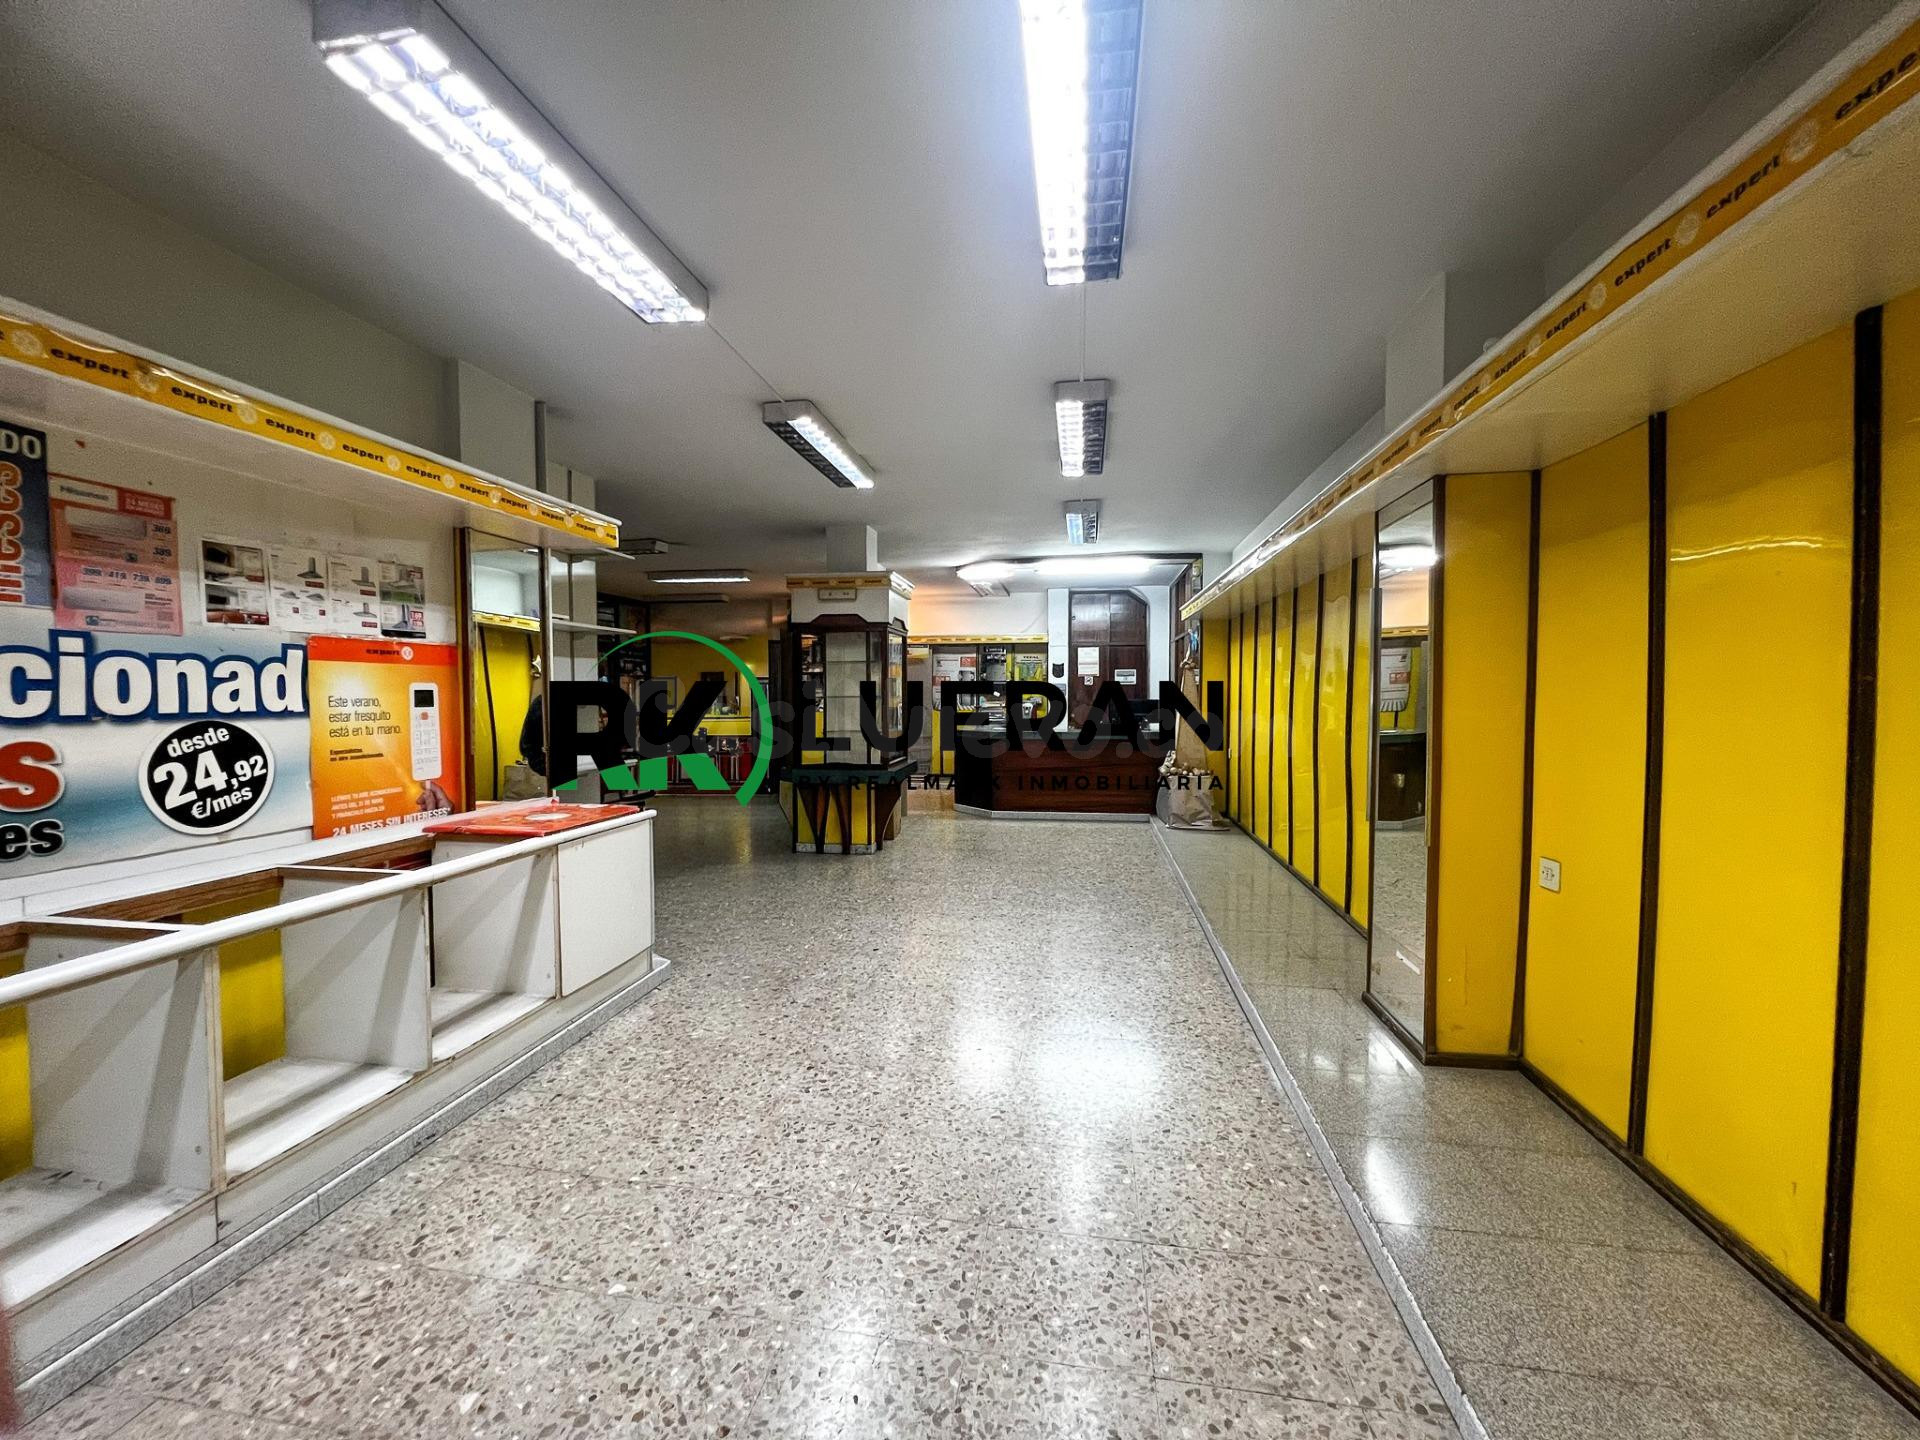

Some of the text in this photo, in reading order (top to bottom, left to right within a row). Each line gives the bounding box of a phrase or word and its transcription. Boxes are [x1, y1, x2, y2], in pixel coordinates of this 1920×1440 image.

[1546, 302, 1587, 339] expert
[1614, 238, 1672, 287] expert
[1706, 155, 1780, 219] expert
[1835, 46, 1920, 120] expe
[50, 347, 130, 380] expert
[171, 386, 233, 413] expert
[265, 417, 316, 441] expert
[342, 443, 384, 463] expert
[405, 464, 441, 482] expert
[459, 483, 489, 497] expert
[501, 497, 528, 510] expert
[0, 636, 305, 718] cionad
[328, 695, 382, 709] Este verano,
[328, 709, 391, 724] estar fresquito
[167, 727, 230, 758] desde
[329, 723, 402, 738] está en tu mano.
[153, 749, 267, 811] 24,92
[190, 786, 253, 820] €/mes
[349, 819, 384, 835] MESES
[385, 815, 401, 828] SIN
